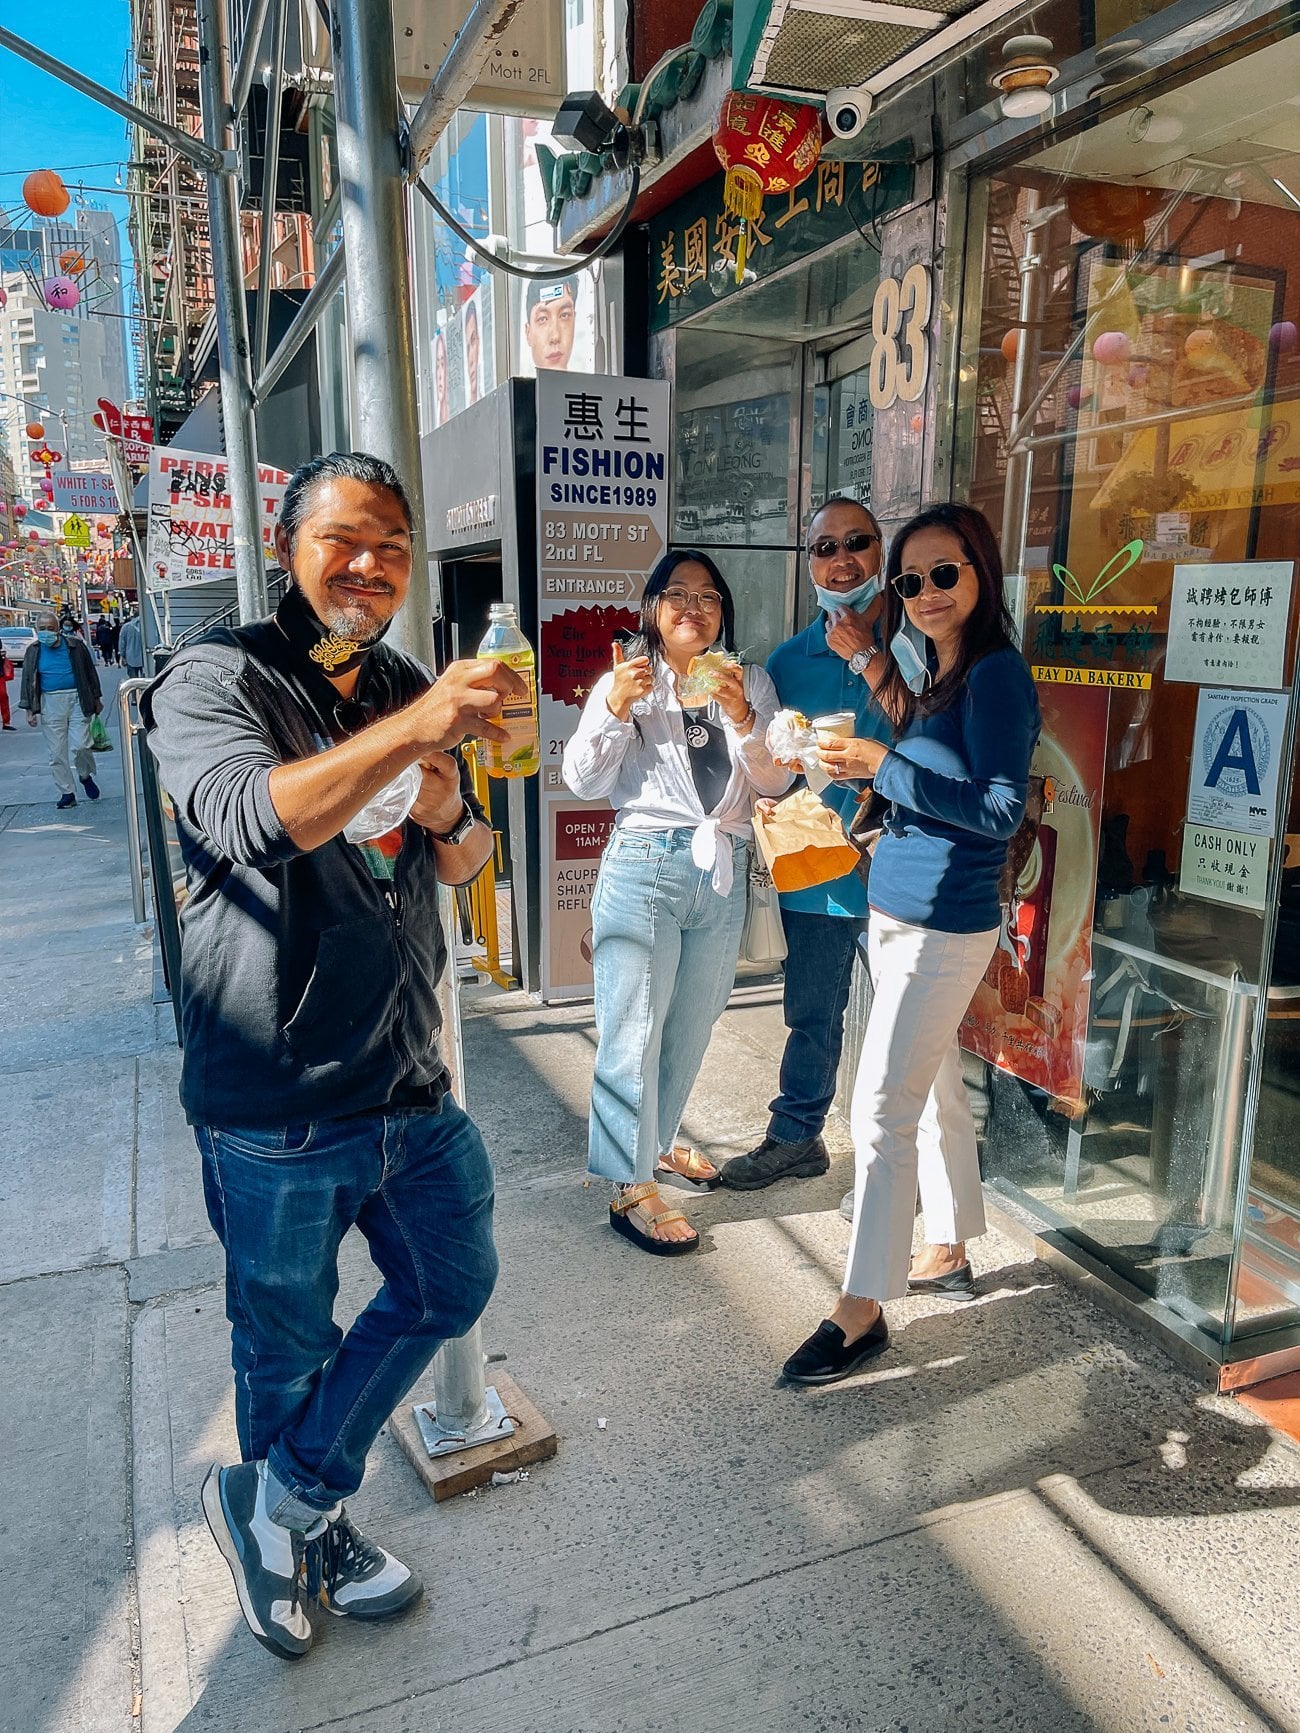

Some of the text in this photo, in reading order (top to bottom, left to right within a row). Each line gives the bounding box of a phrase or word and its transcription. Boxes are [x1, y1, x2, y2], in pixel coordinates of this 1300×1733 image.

[490, 62, 551, 84] Mott 2FL
[869, 264, 932, 410] 83
[563, 392, 651, 442] 惠生
[543, 446, 664, 480] FISHION
[57, 477, 87, 490] WHITE
[71, 495, 77, 507] 5
[80, 496, 97, 508] FOR
[545, 521, 649, 542] 83 MOTT ST
[187, 552, 236, 569] BEL
[545, 543, 603, 562] 2nd FL
[546, 578, 625, 594] ENTRANCE
[1037, 668, 1144, 687] FAY DA BAKERY
[1203, 709, 1261, 795] A
[1249, 806, 1267, 816] NYC
[565, 823, 595, 835] OPEN
[599, 823, 605, 833] 7
[575, 836, 610, 848] 11AM-
[1194, 833, 1257, 858] CASH ONLY
[1198, 857, 1251, 879] 只收現金
[557, 897, 592, 910] REFL
